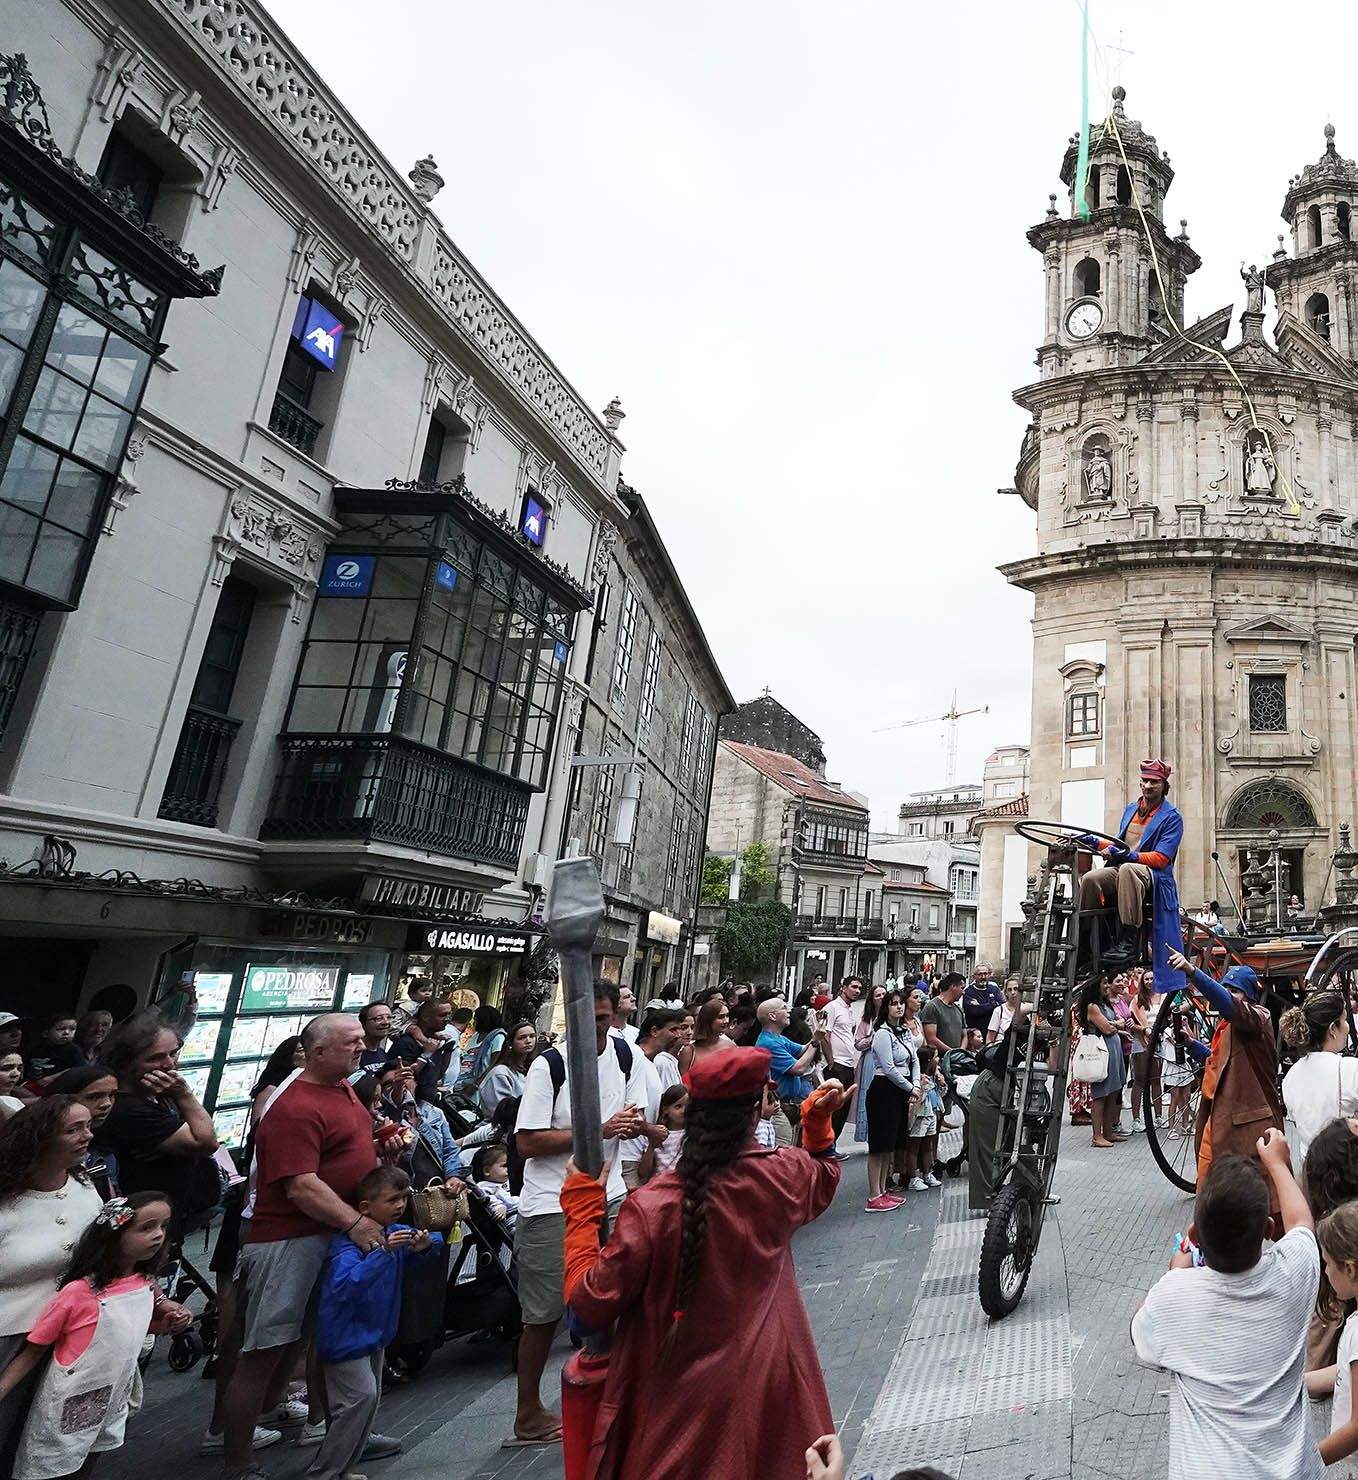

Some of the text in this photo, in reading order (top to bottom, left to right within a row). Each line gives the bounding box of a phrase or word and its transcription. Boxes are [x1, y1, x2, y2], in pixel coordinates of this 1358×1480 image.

[306, 327, 335, 359] AXA
[328, 580, 362, 588] ZURICH
[438, 931, 494, 951] AGASALLO
[264, 971, 330, 991] PEDROSA
